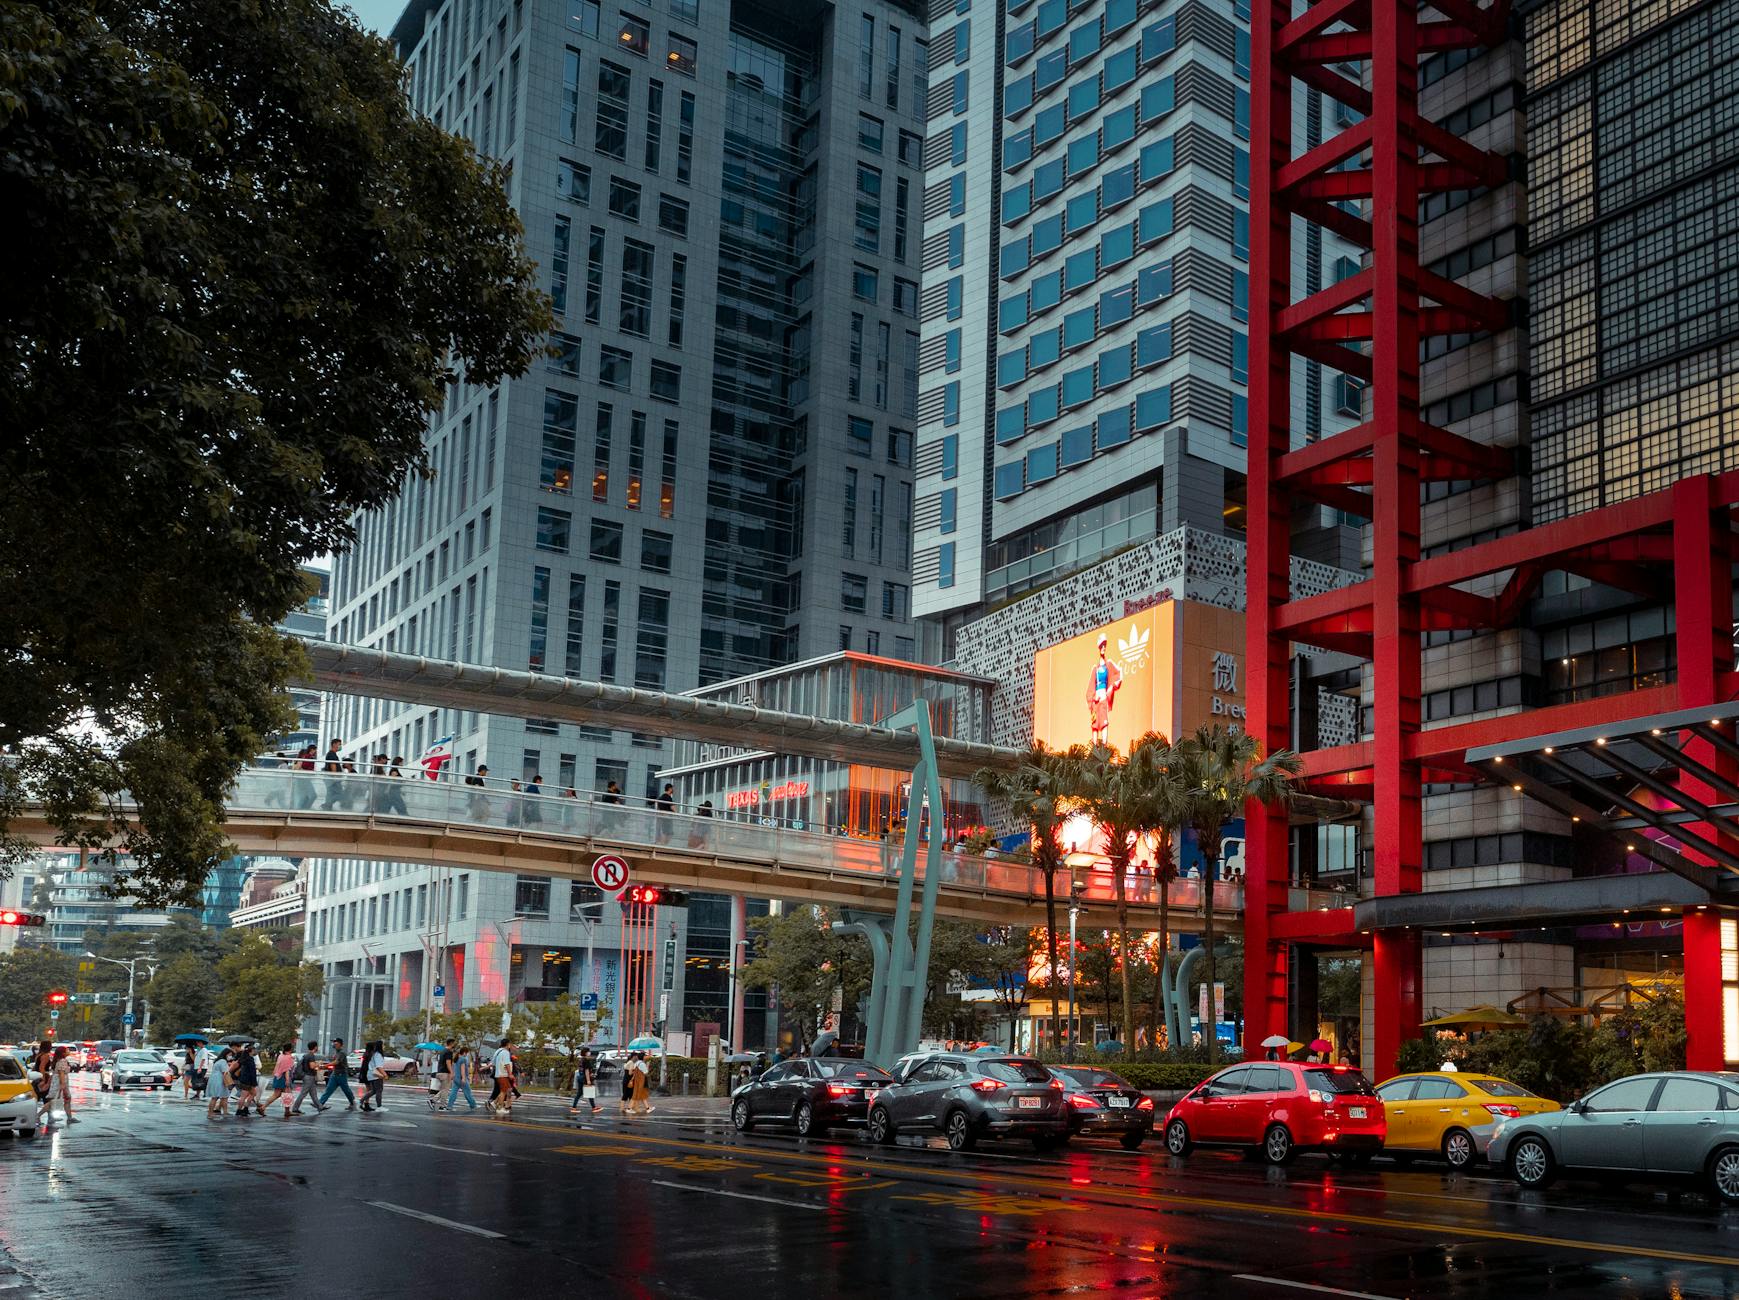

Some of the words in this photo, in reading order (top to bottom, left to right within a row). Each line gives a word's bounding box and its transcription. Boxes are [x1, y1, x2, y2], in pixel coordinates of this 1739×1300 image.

[1212, 652, 1238, 693] 微
[727, 790, 759, 809] TEXAS
[605, 960, 617, 1004] 新光銀行
[582, 994, 592, 1005] P
